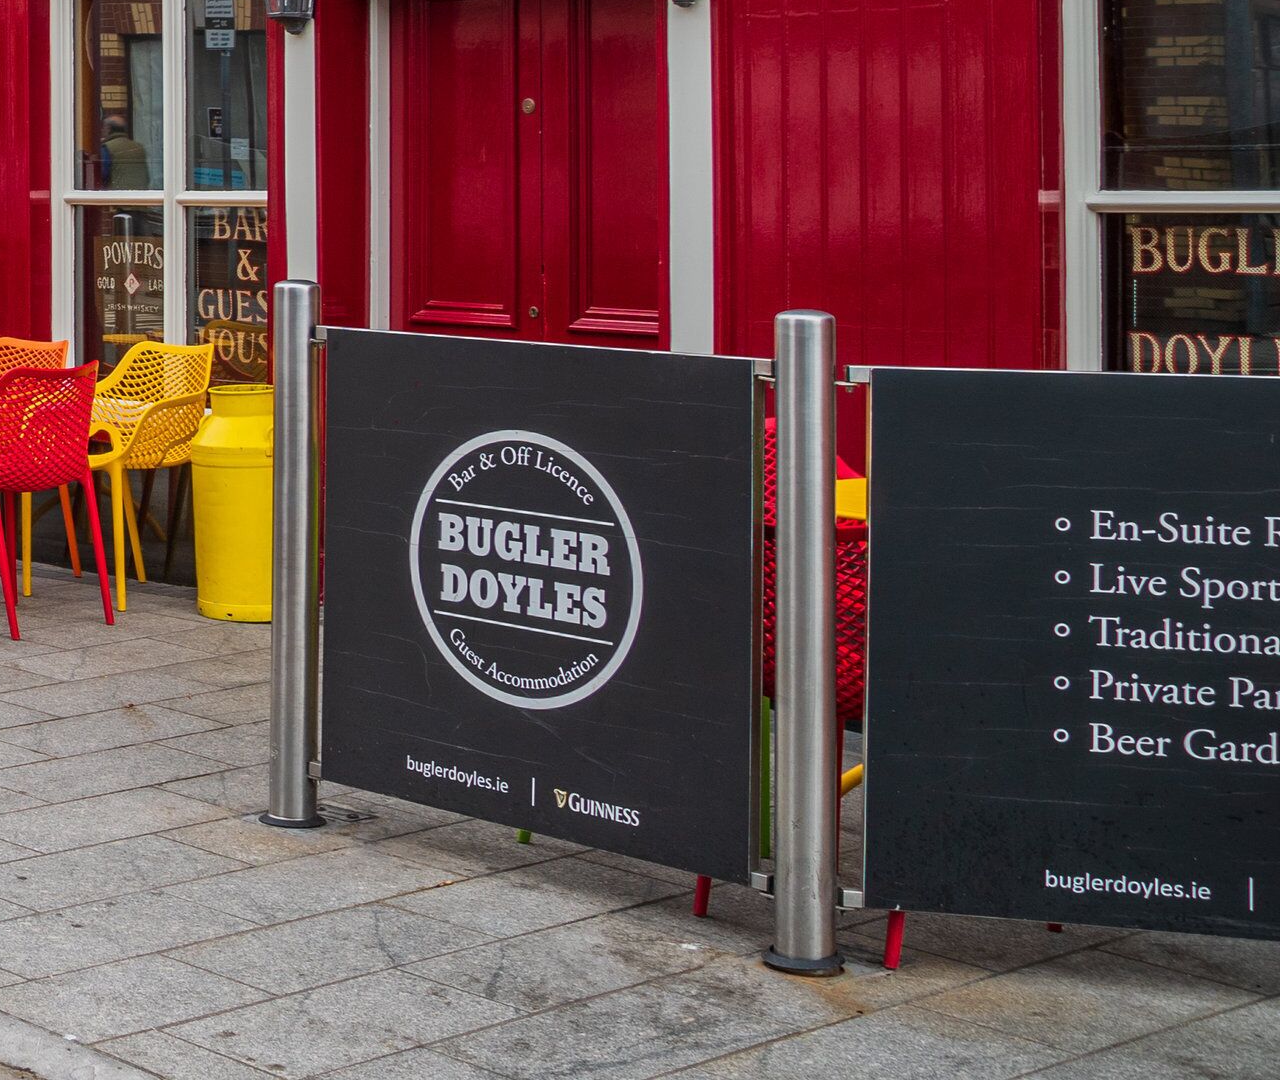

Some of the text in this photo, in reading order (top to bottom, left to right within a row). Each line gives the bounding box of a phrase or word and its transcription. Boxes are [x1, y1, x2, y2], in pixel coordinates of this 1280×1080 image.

[213, 209, 268, 241] BAR
[103, 241, 164, 269] POWERS
[236, 249, 259, 281] &
[1131, 227, 1280, 275] BUGL
[97, 277, 115, 289] GOLD
[198, 289, 268, 322] GUES
[1130, 332, 1280, 375] DOYL
[448, 446, 594, 505] Bar & Off Licence
[438, 512, 611, 576] BUGLER
[1089, 509, 1251, 546] En-Suite
[440, 564, 607, 629] DOYLES
[1089, 563, 1280, 608] Live Sport
[1089, 616, 1280, 656] Traditiona
[450, 627, 599, 690] Guest Accommodation
[1089, 669, 1215, 707] Private
[1089, 723, 1280, 765] Beer Gard
[406, 754, 640, 827] buglerdoyles.ie GUINNESS
[1044, 869, 1211, 901] buglerdoyles.ie
